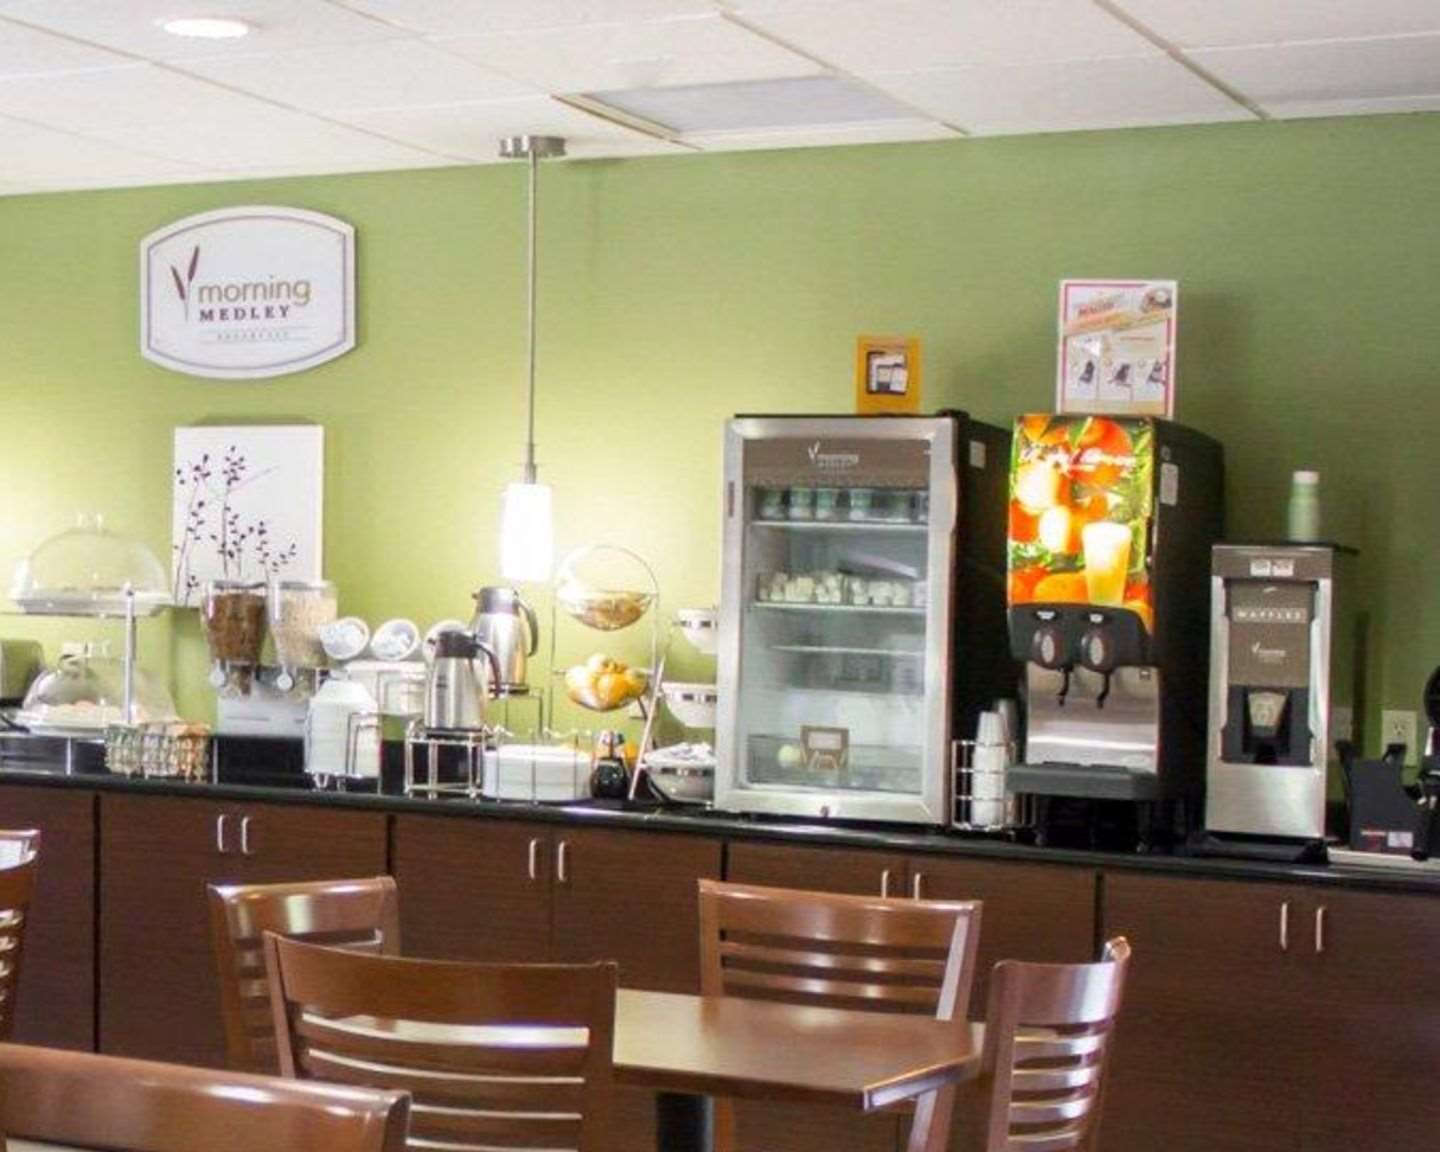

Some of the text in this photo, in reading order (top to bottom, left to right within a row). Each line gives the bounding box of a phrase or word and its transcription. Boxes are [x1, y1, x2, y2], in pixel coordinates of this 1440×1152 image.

[198, 274, 311, 306] morning
[199, 305, 289, 321] MEDLEY
[1236, 610, 1301, 620] WAFFLES
